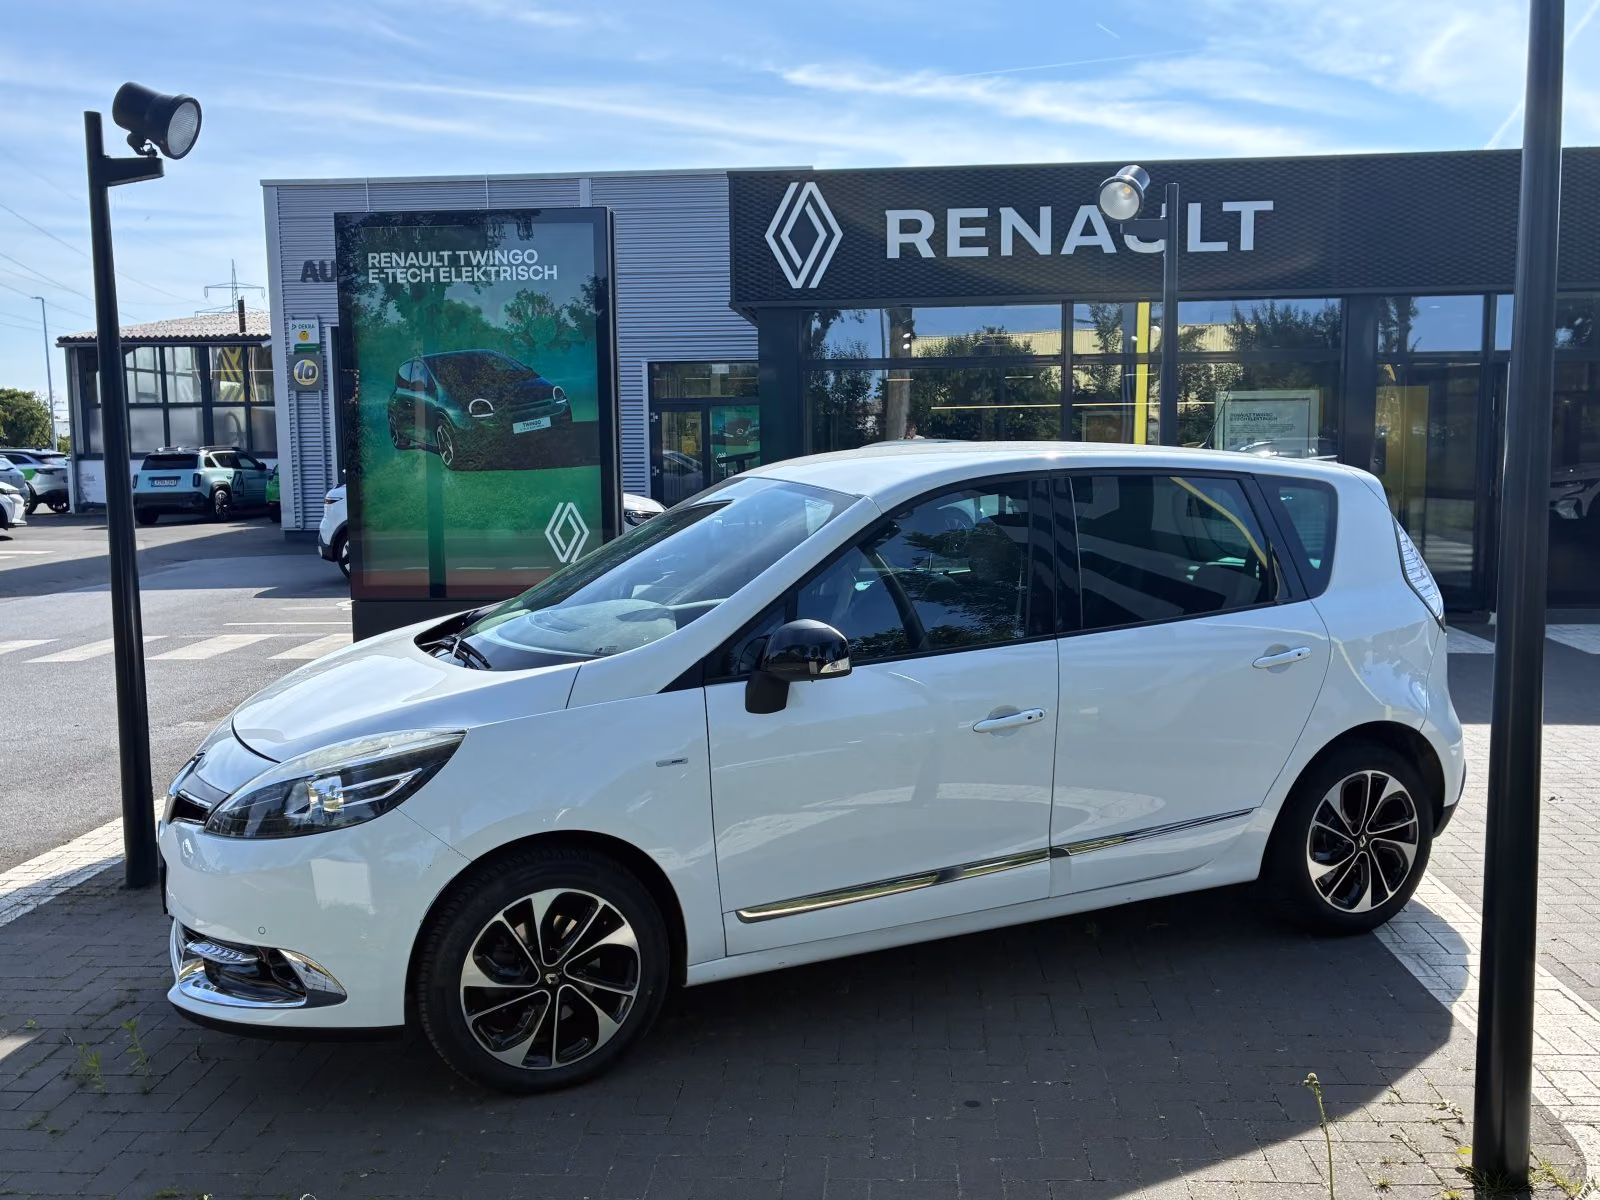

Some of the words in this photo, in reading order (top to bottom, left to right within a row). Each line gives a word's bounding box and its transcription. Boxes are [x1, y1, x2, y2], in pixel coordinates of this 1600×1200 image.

[368, 250, 452, 268] RENAULT
[456, 249, 538, 266] TWINGO
[368, 267, 434, 284] E-TECH
[439, 265, 558, 283] ELEKTRISCH
